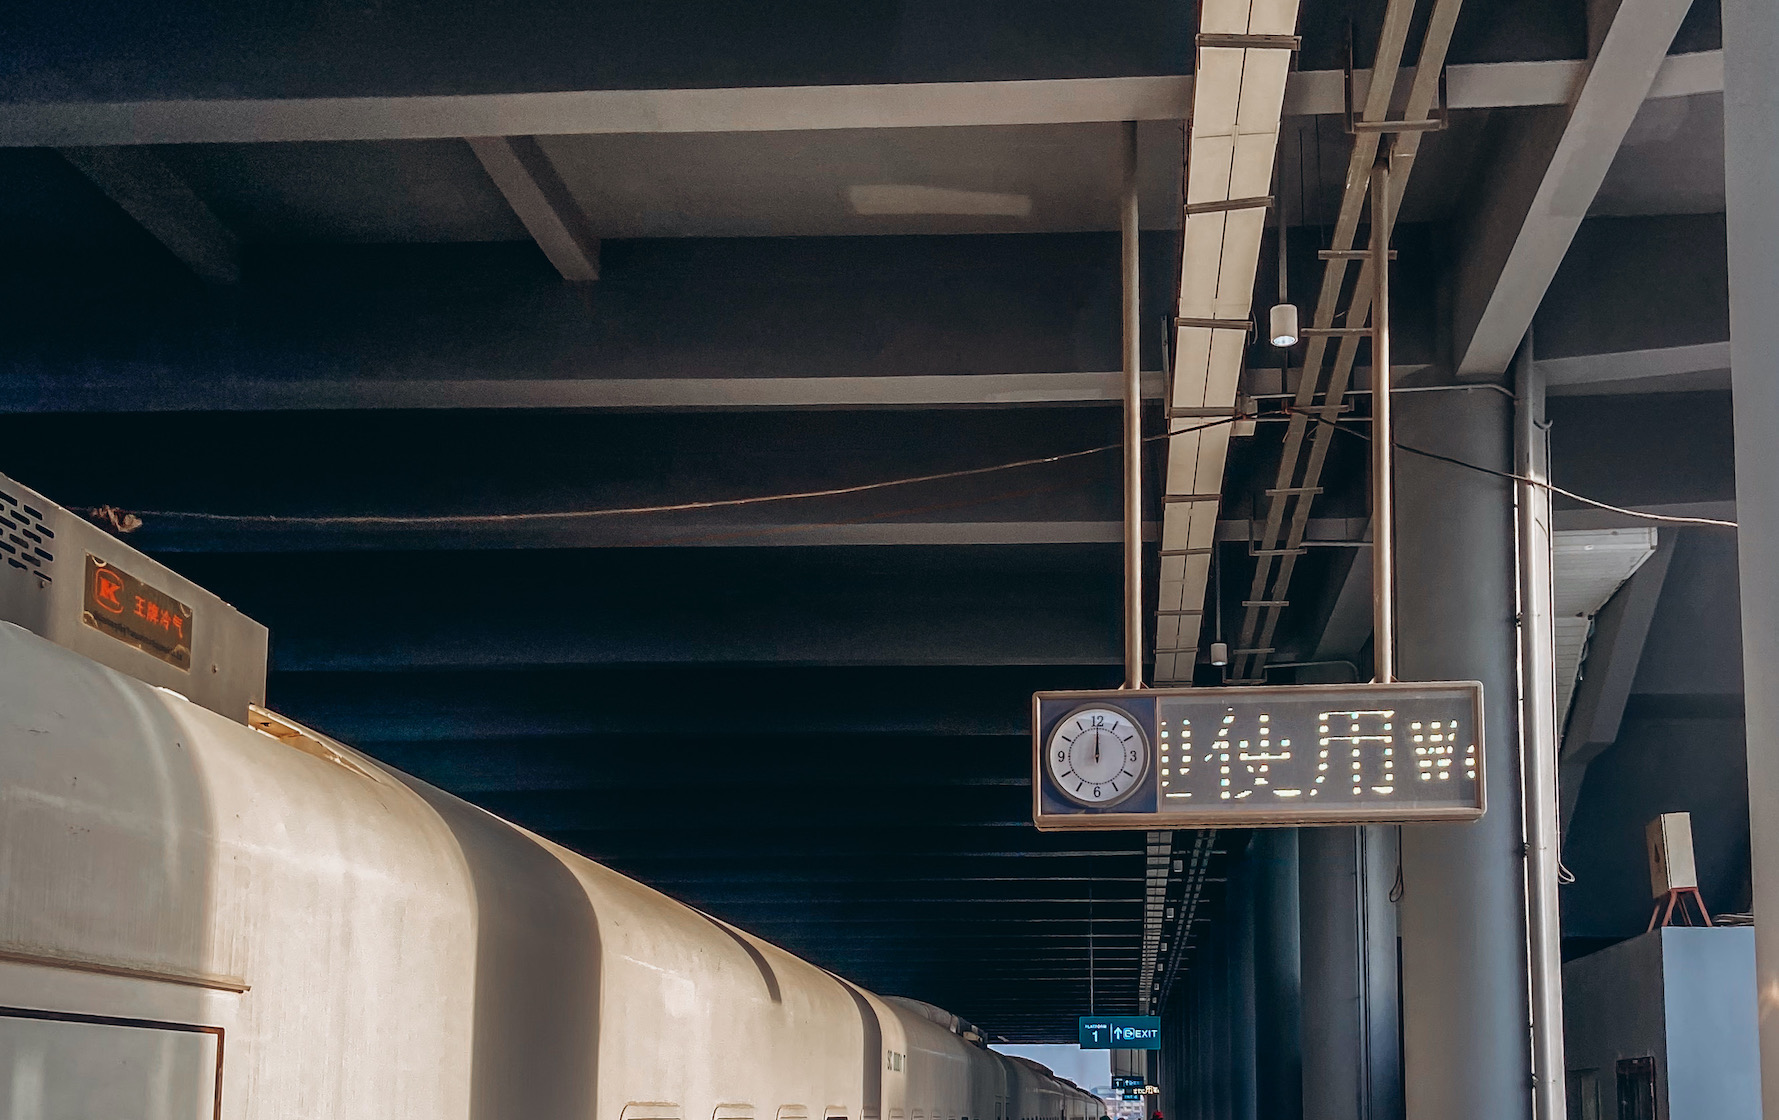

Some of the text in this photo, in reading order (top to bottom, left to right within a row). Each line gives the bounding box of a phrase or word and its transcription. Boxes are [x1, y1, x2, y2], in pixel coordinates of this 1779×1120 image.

[1091, 715, 1104, 727] 12
[1058, 750, 1065, 762] 9
[1130, 750, 1137, 762] 3
[1093, 786, 1101, 798] 6
[1092, 1030, 1098, 1042] 1
[1135, 1029, 1158, 1038] EXIT
